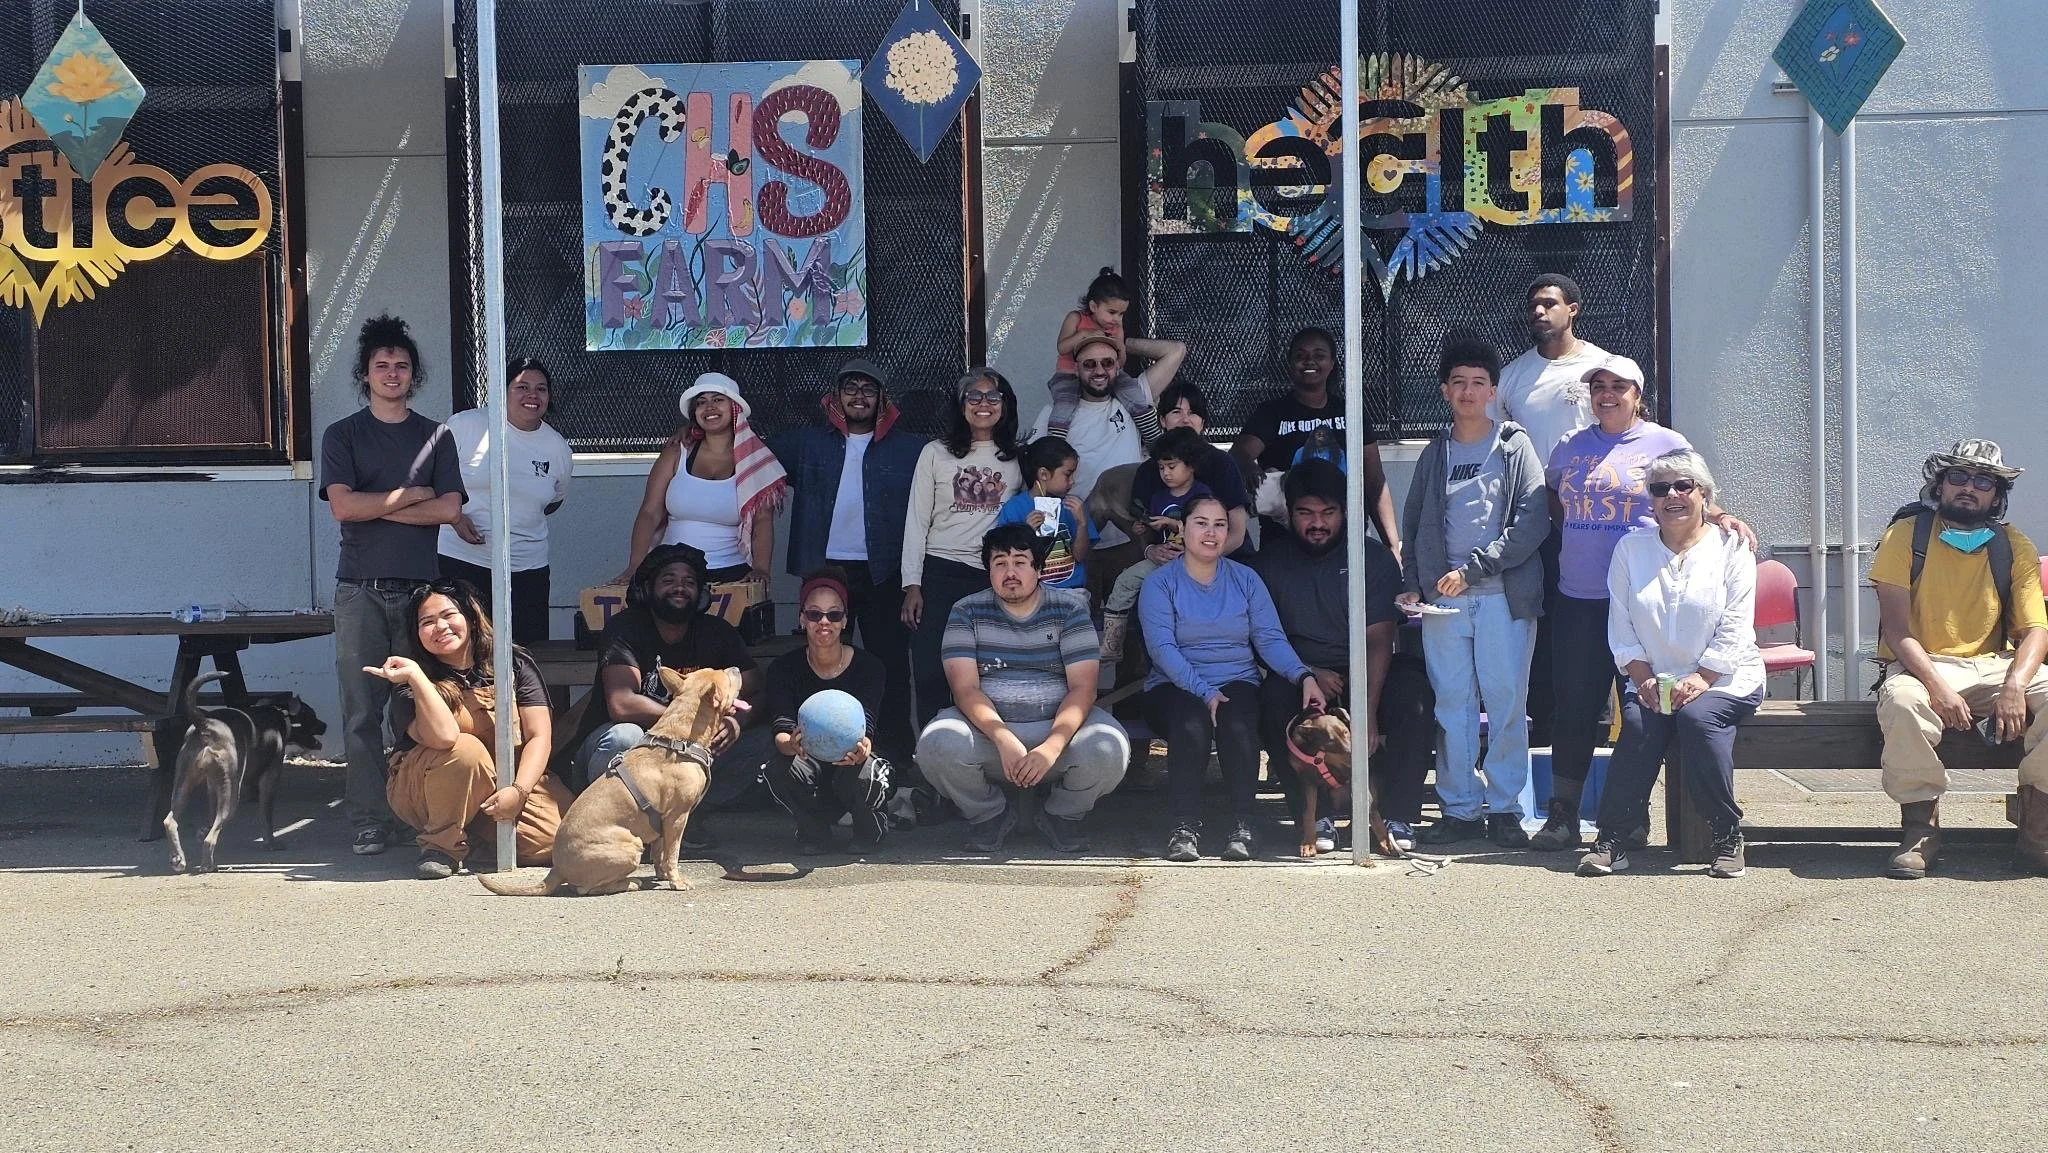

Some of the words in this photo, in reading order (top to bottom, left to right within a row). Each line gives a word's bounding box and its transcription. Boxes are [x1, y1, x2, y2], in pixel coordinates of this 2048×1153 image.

[602, 85, 852, 238] CHS
[1160, 102, 1619, 221] health
[0, 163, 262, 250] tice
[600, 239, 832, 329] FARM
[1449, 463, 1482, 481] NIKE
[1569, 522, 1590, 530] YEARS
[1591, 523, 1603, 531] OF
